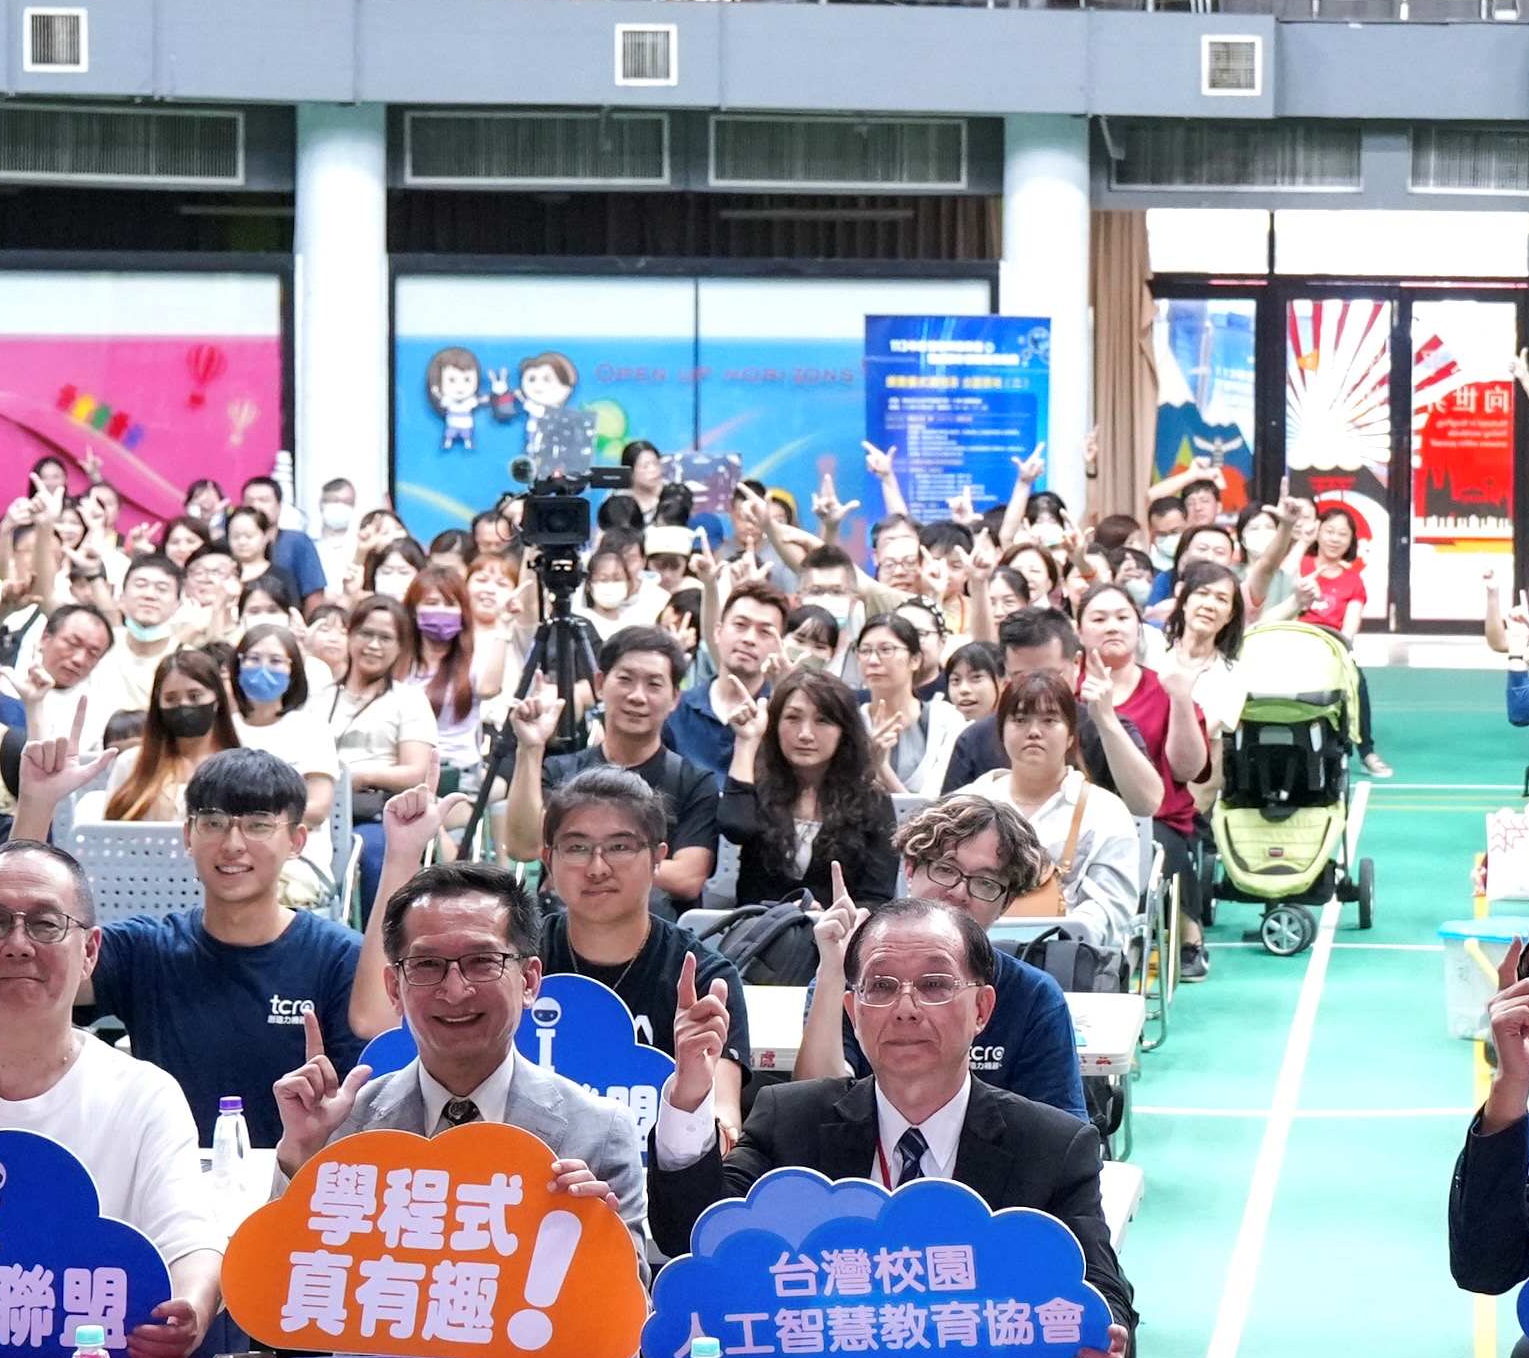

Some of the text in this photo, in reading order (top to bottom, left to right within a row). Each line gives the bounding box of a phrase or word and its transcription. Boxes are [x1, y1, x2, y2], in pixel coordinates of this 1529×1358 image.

[308, 1161, 523, 1256] 學程式
[769, 1244, 976, 1298] 台灣校園
